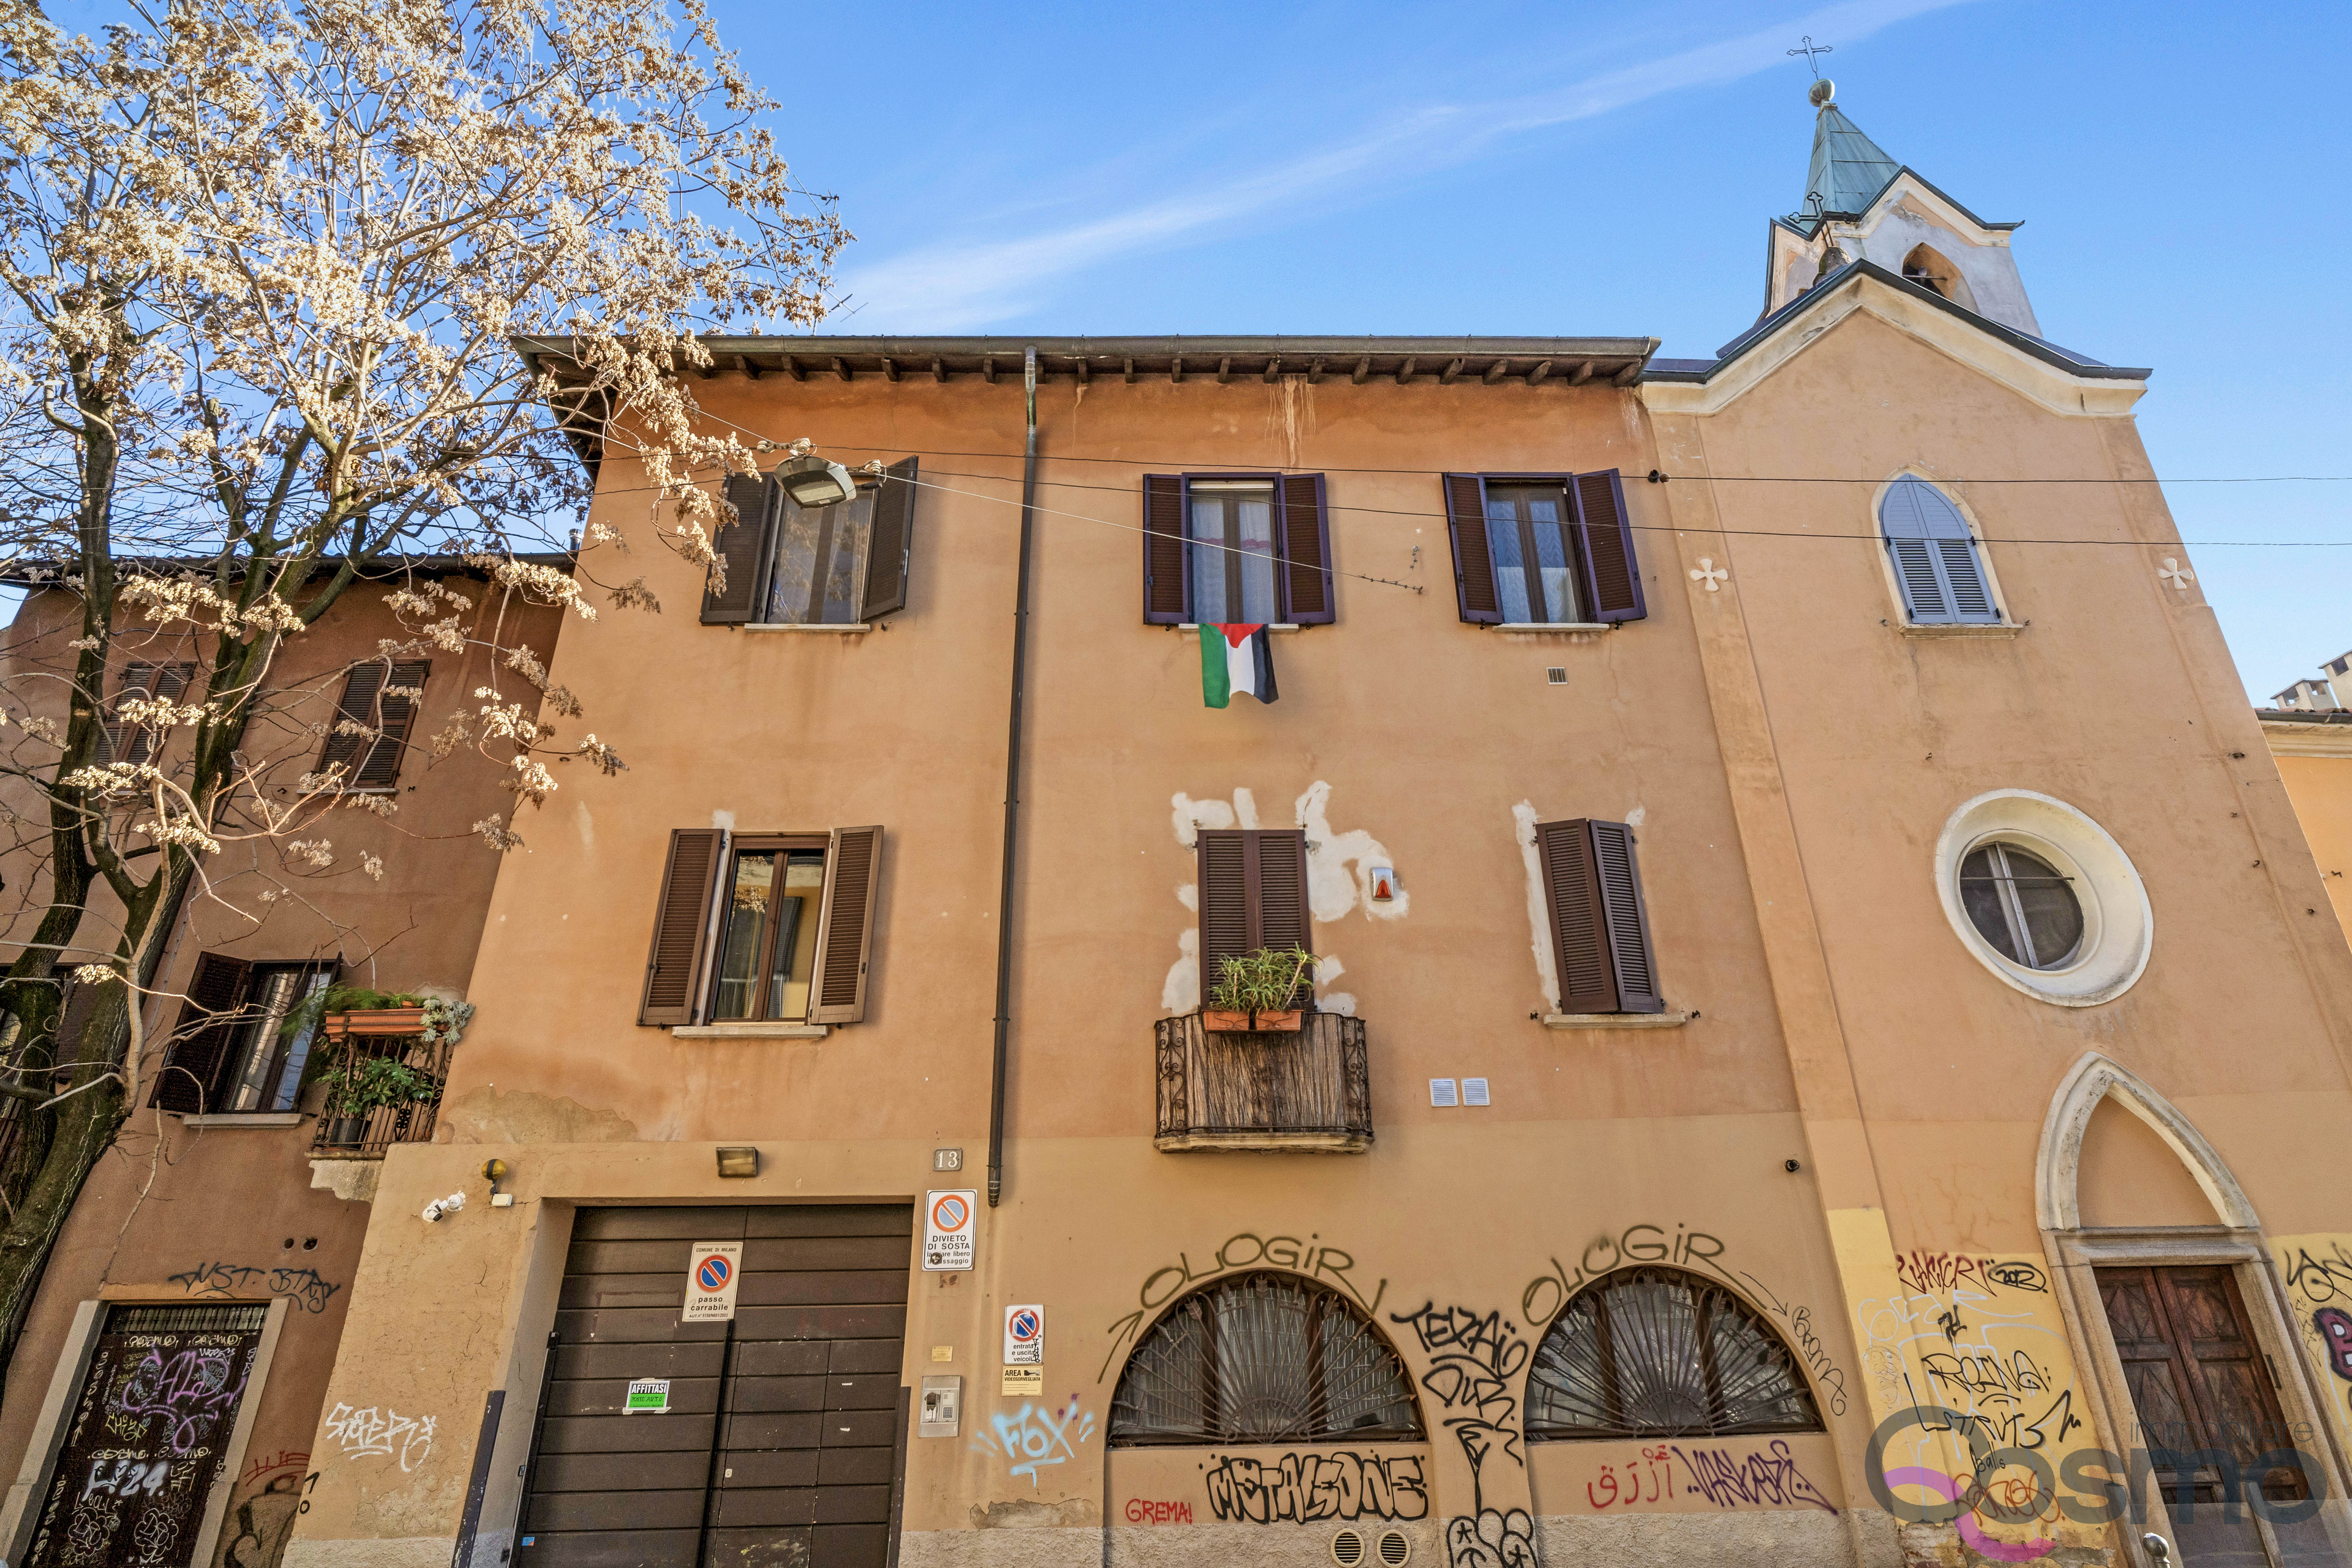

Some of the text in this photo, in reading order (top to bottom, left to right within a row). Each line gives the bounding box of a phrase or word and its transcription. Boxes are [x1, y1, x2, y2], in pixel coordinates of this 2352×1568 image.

[937, 1151, 958, 1168] 13
[632, 1384, 667, 1394] AFFITTASI
[1125, 1498, 1193, 1525] GREMA!
